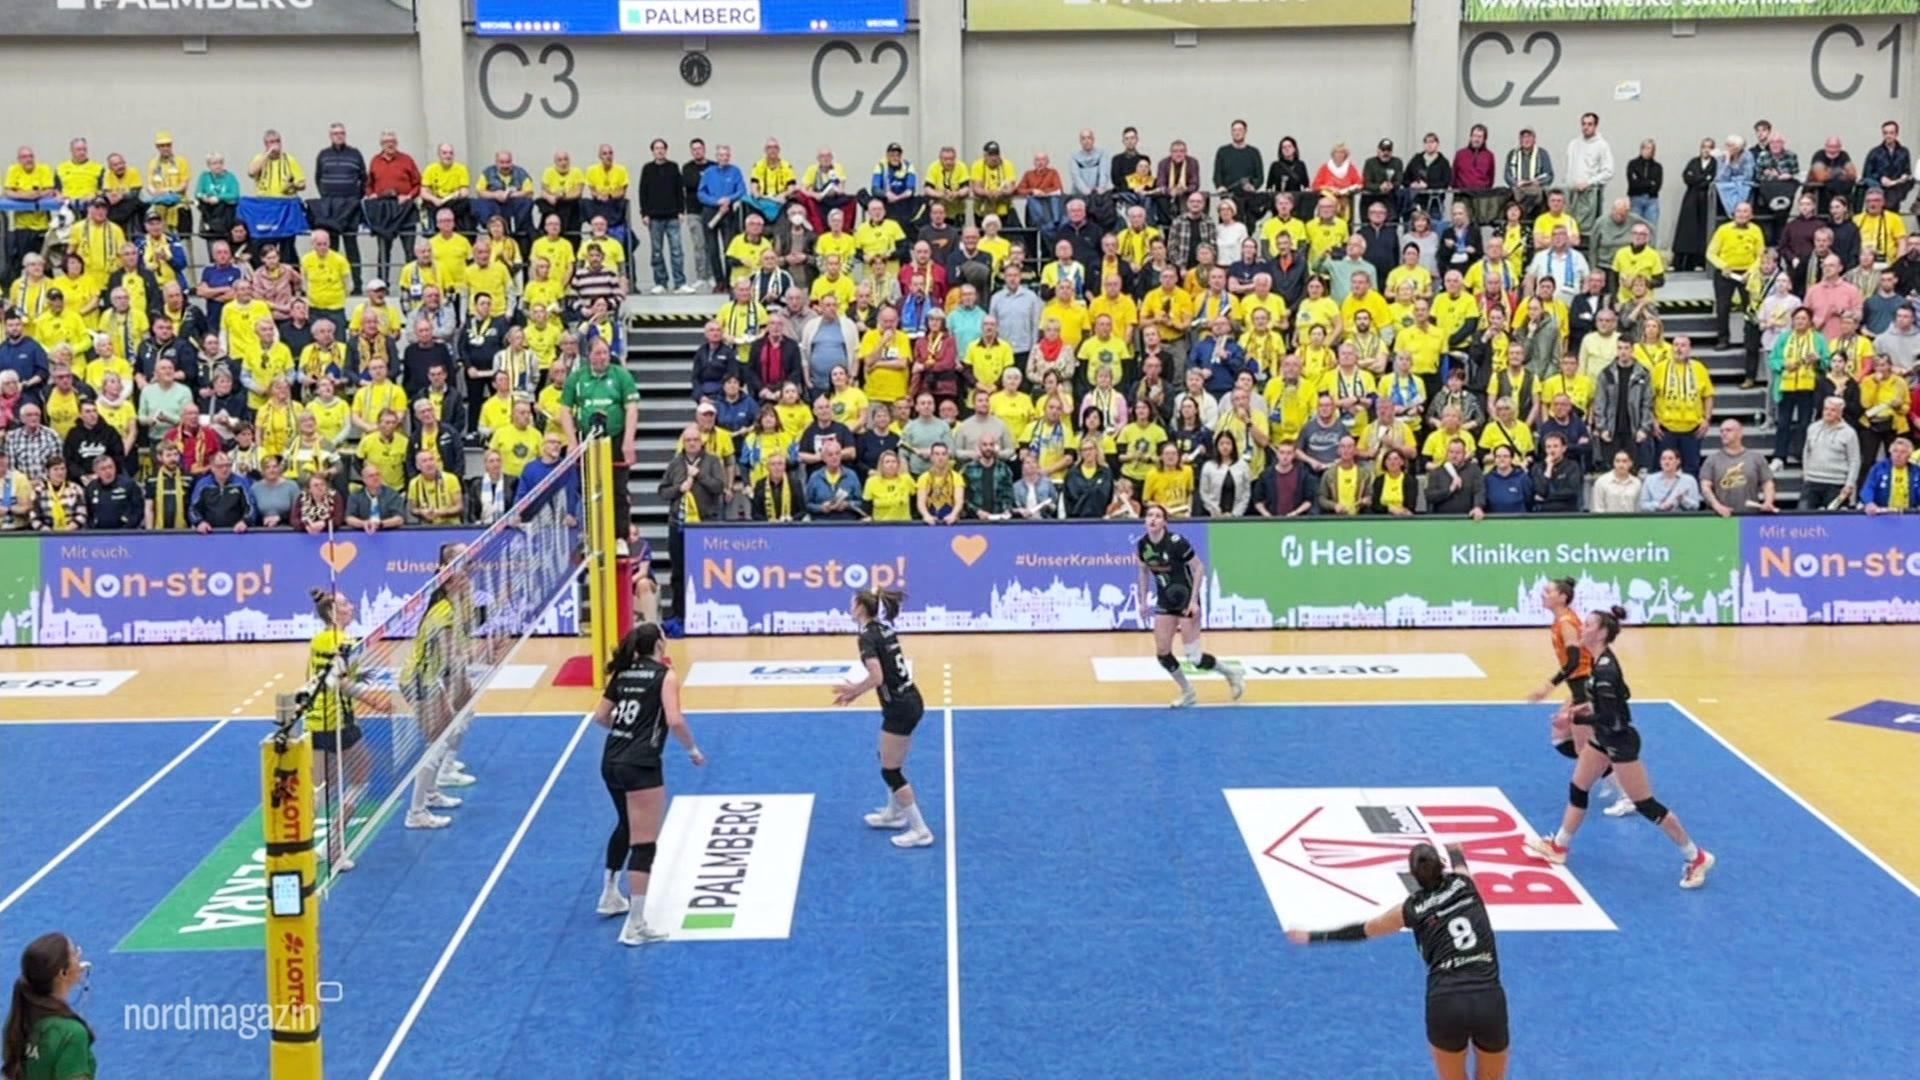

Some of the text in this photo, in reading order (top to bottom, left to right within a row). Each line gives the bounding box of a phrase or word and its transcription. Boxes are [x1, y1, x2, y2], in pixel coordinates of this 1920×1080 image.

[646, 8, 756, 25] PALMBERG
[811, 40, 909, 117] C2
[1461, 31, 1562, 108] C2
[1811, 23, 1901, 101] C1
[479, 43, 579, 120] C3
[703, 536, 771, 550] Mit euch.
[1760, 525, 1829, 540] Mit euch.
[61, 545, 132, 559] Mit euch.
[1311, 538, 1411, 565] Helios
[1451, 541, 1669, 565] Kliniken Schwerin
[60, 564, 272, 602] Non-stop!
[703, 557, 907, 591] Non-stop!
[688, 801, 764, 909] PALMBERG
[1418, 805, 1583, 905] BAU
[1448, 916, 1478, 951] 8
